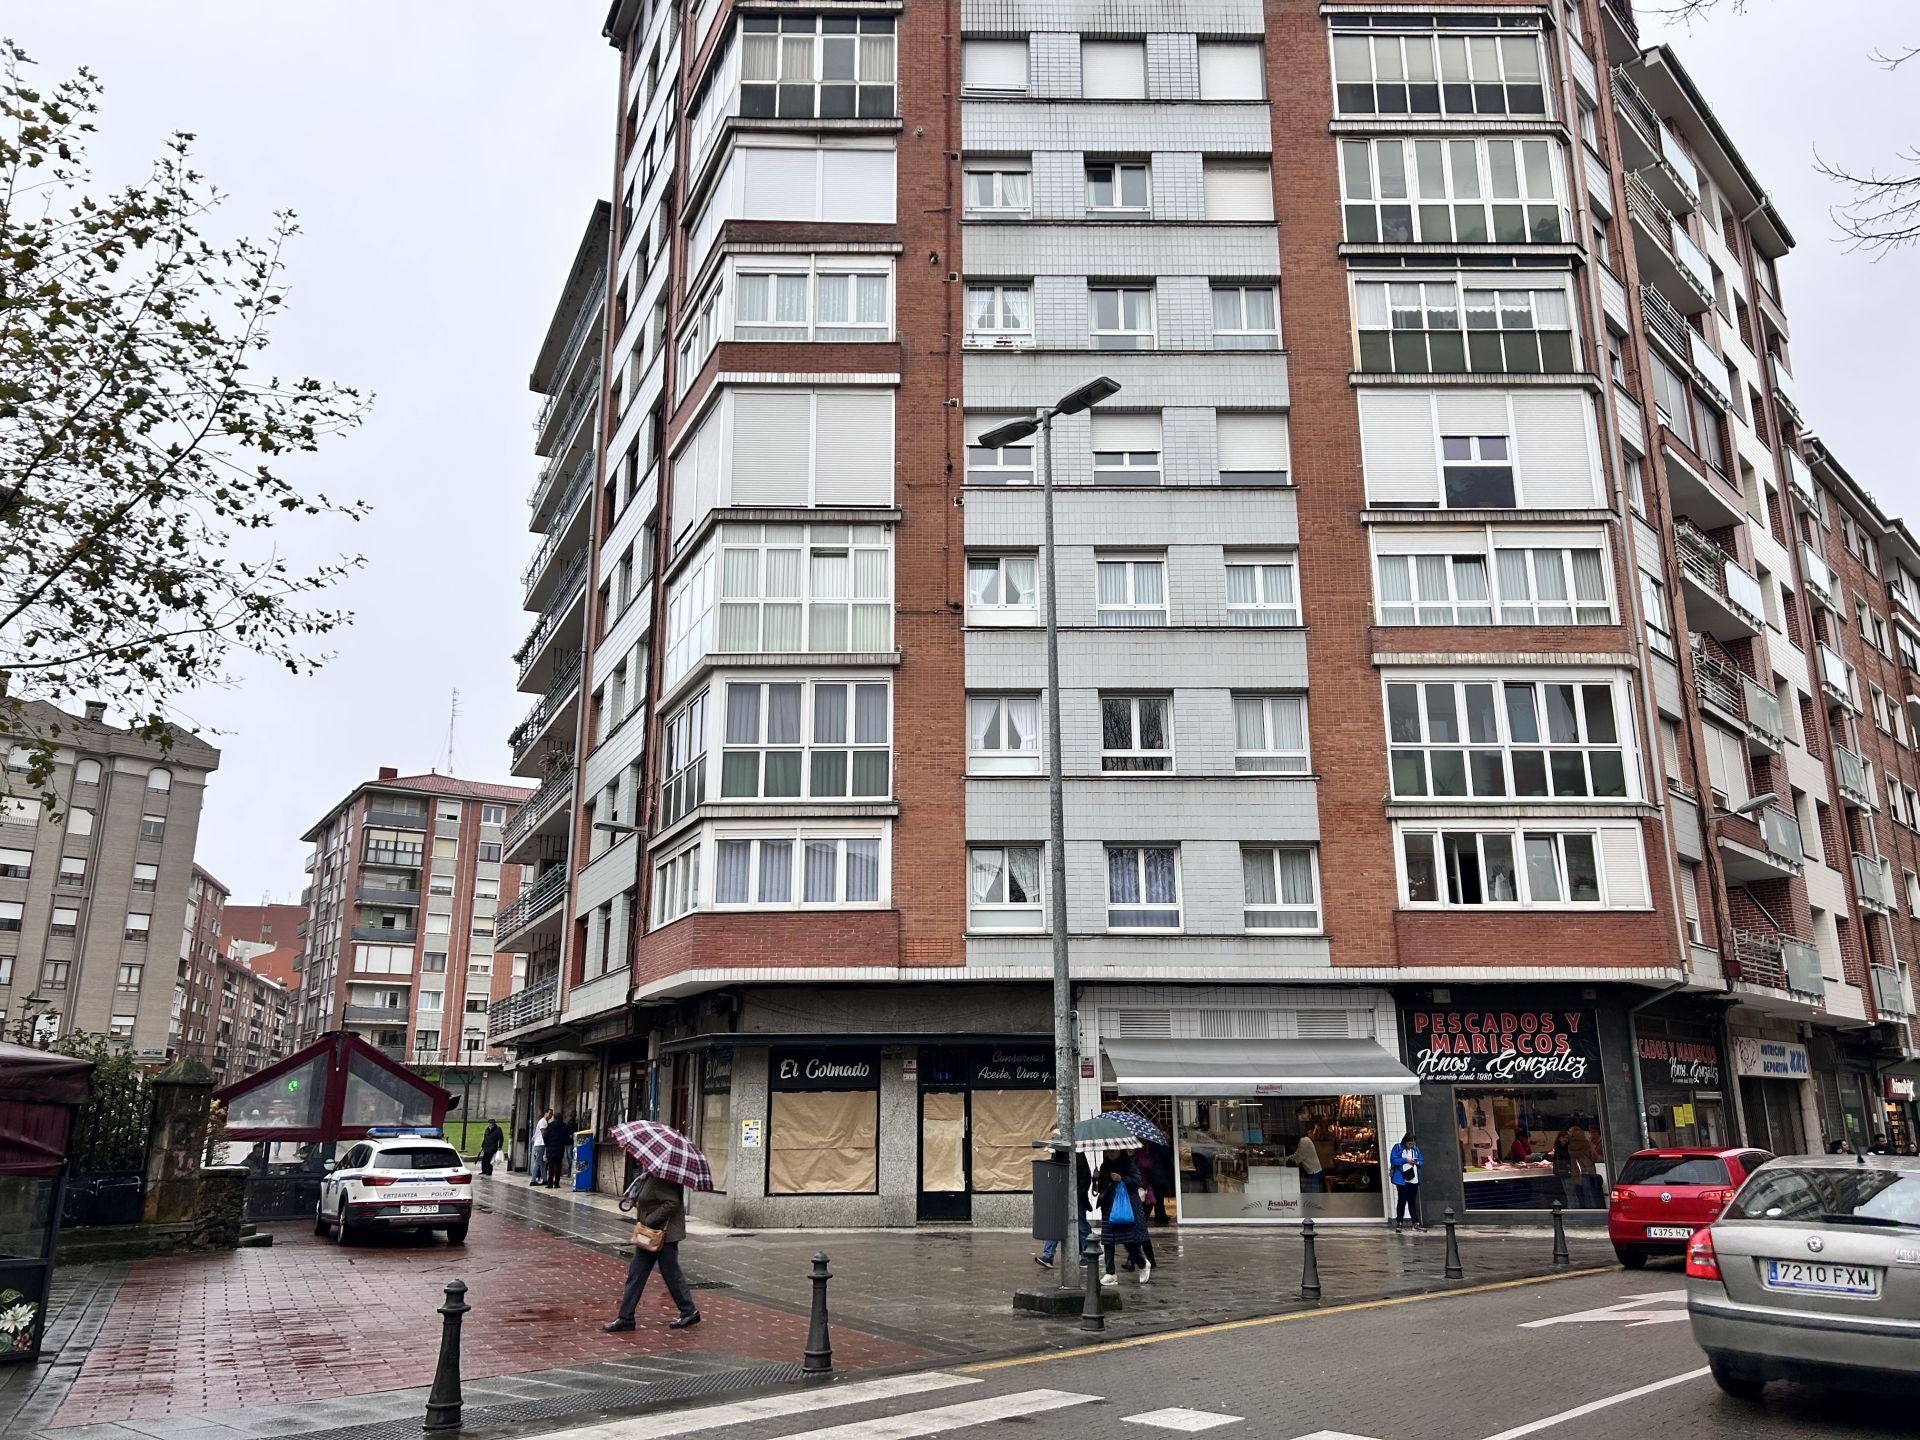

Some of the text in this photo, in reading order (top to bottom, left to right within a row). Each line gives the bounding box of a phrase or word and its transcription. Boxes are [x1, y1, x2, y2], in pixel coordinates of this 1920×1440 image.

[1414, 1012, 1581, 1034] PESCADOS Y
[1430, 1033, 1570, 1055] MARISCOS
[1639, 1038, 1668, 1060] CADOS
[780, 1058, 870, 1079] El Colmado
[1015, 1065, 1040, 1079] Vino
[1416, 1048, 1587, 1079] Hnos. González
[1653, 1228, 1674, 1237] 4375
[1779, 1263, 1870, 1287] 7210 FXM
